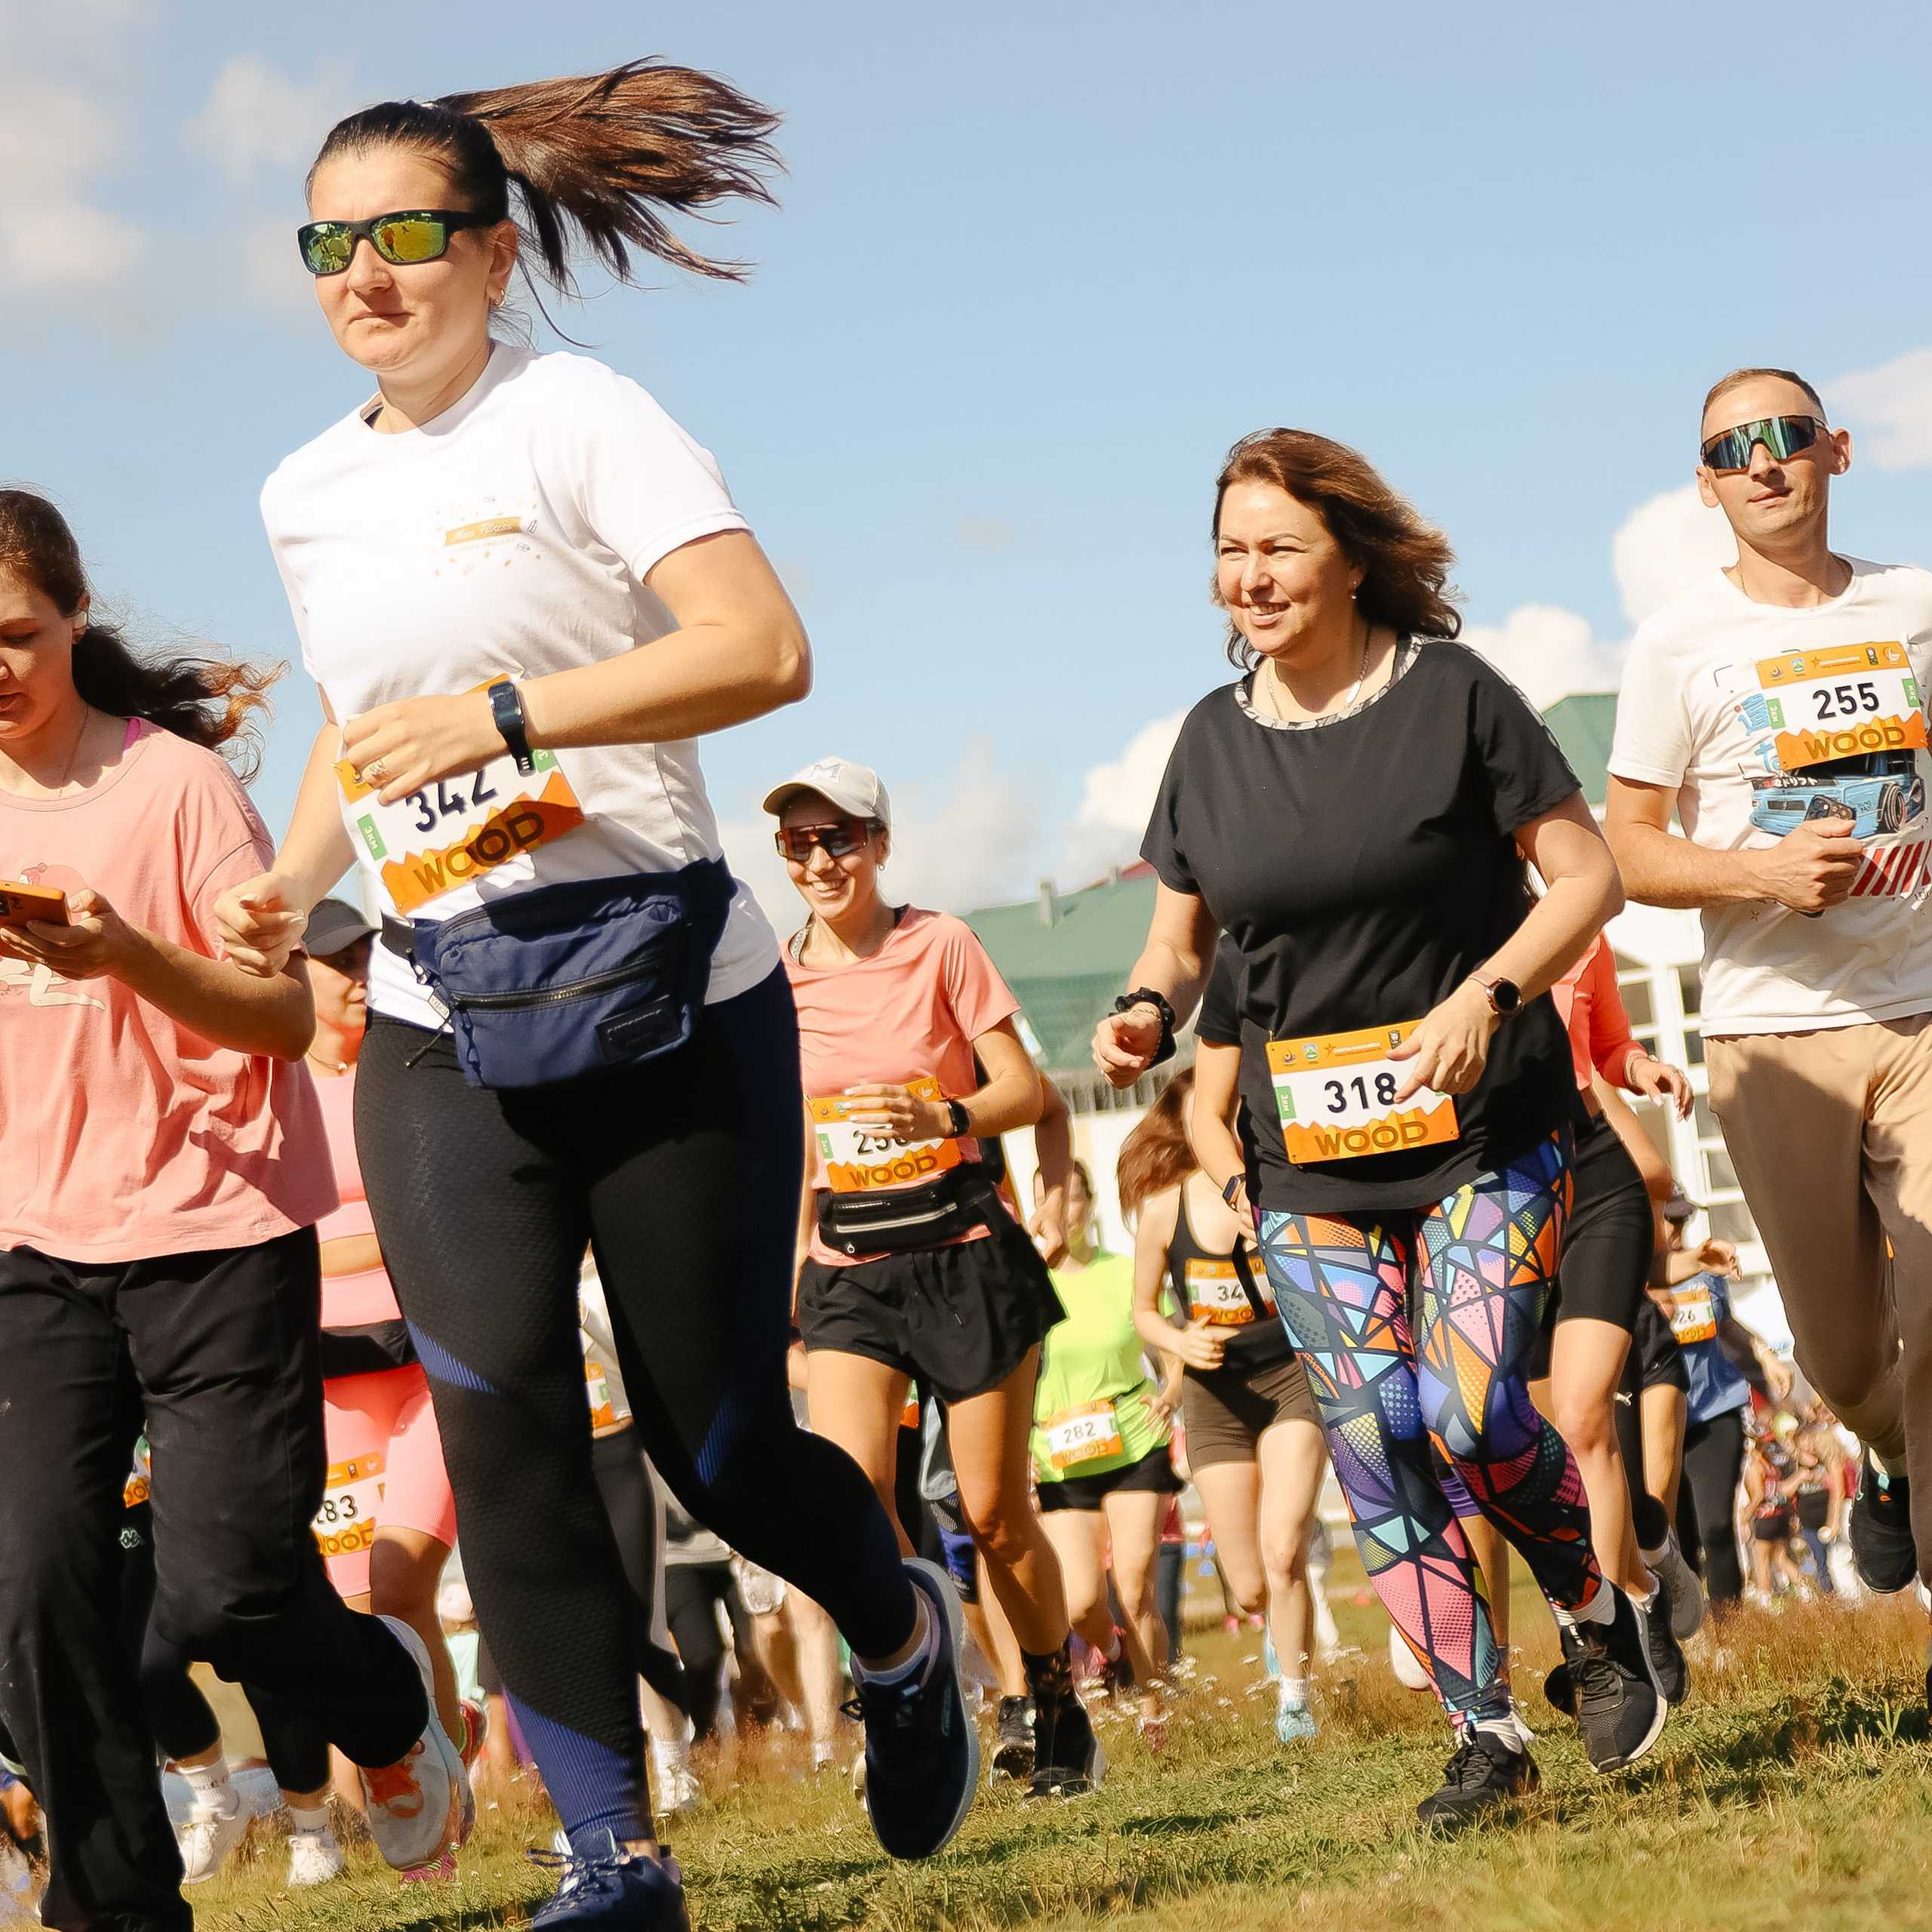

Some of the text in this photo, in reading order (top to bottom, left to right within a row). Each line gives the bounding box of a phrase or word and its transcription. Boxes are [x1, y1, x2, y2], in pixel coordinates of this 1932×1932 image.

[1812, 681, 1879, 720] 255
[1804, 726, 1906, 760] WOOD
[405, 768, 499, 832] 342
[364, 825, 379, 851] 3KM
[413, 811, 545, 894] WOOD
[1324, 1072, 1398, 1114] 318
[853, 1124, 912, 1156] 25
[1315, 1121, 1429, 1156] WOOD
[849, 1155, 938, 1188] WOOD
[1217, 1284, 1244, 1302] 34
[1211, 1308, 1253, 1321] WOO
[1064, 1422, 1097, 1444] 282
[1062, 1441, 1109, 1465] WOOD
